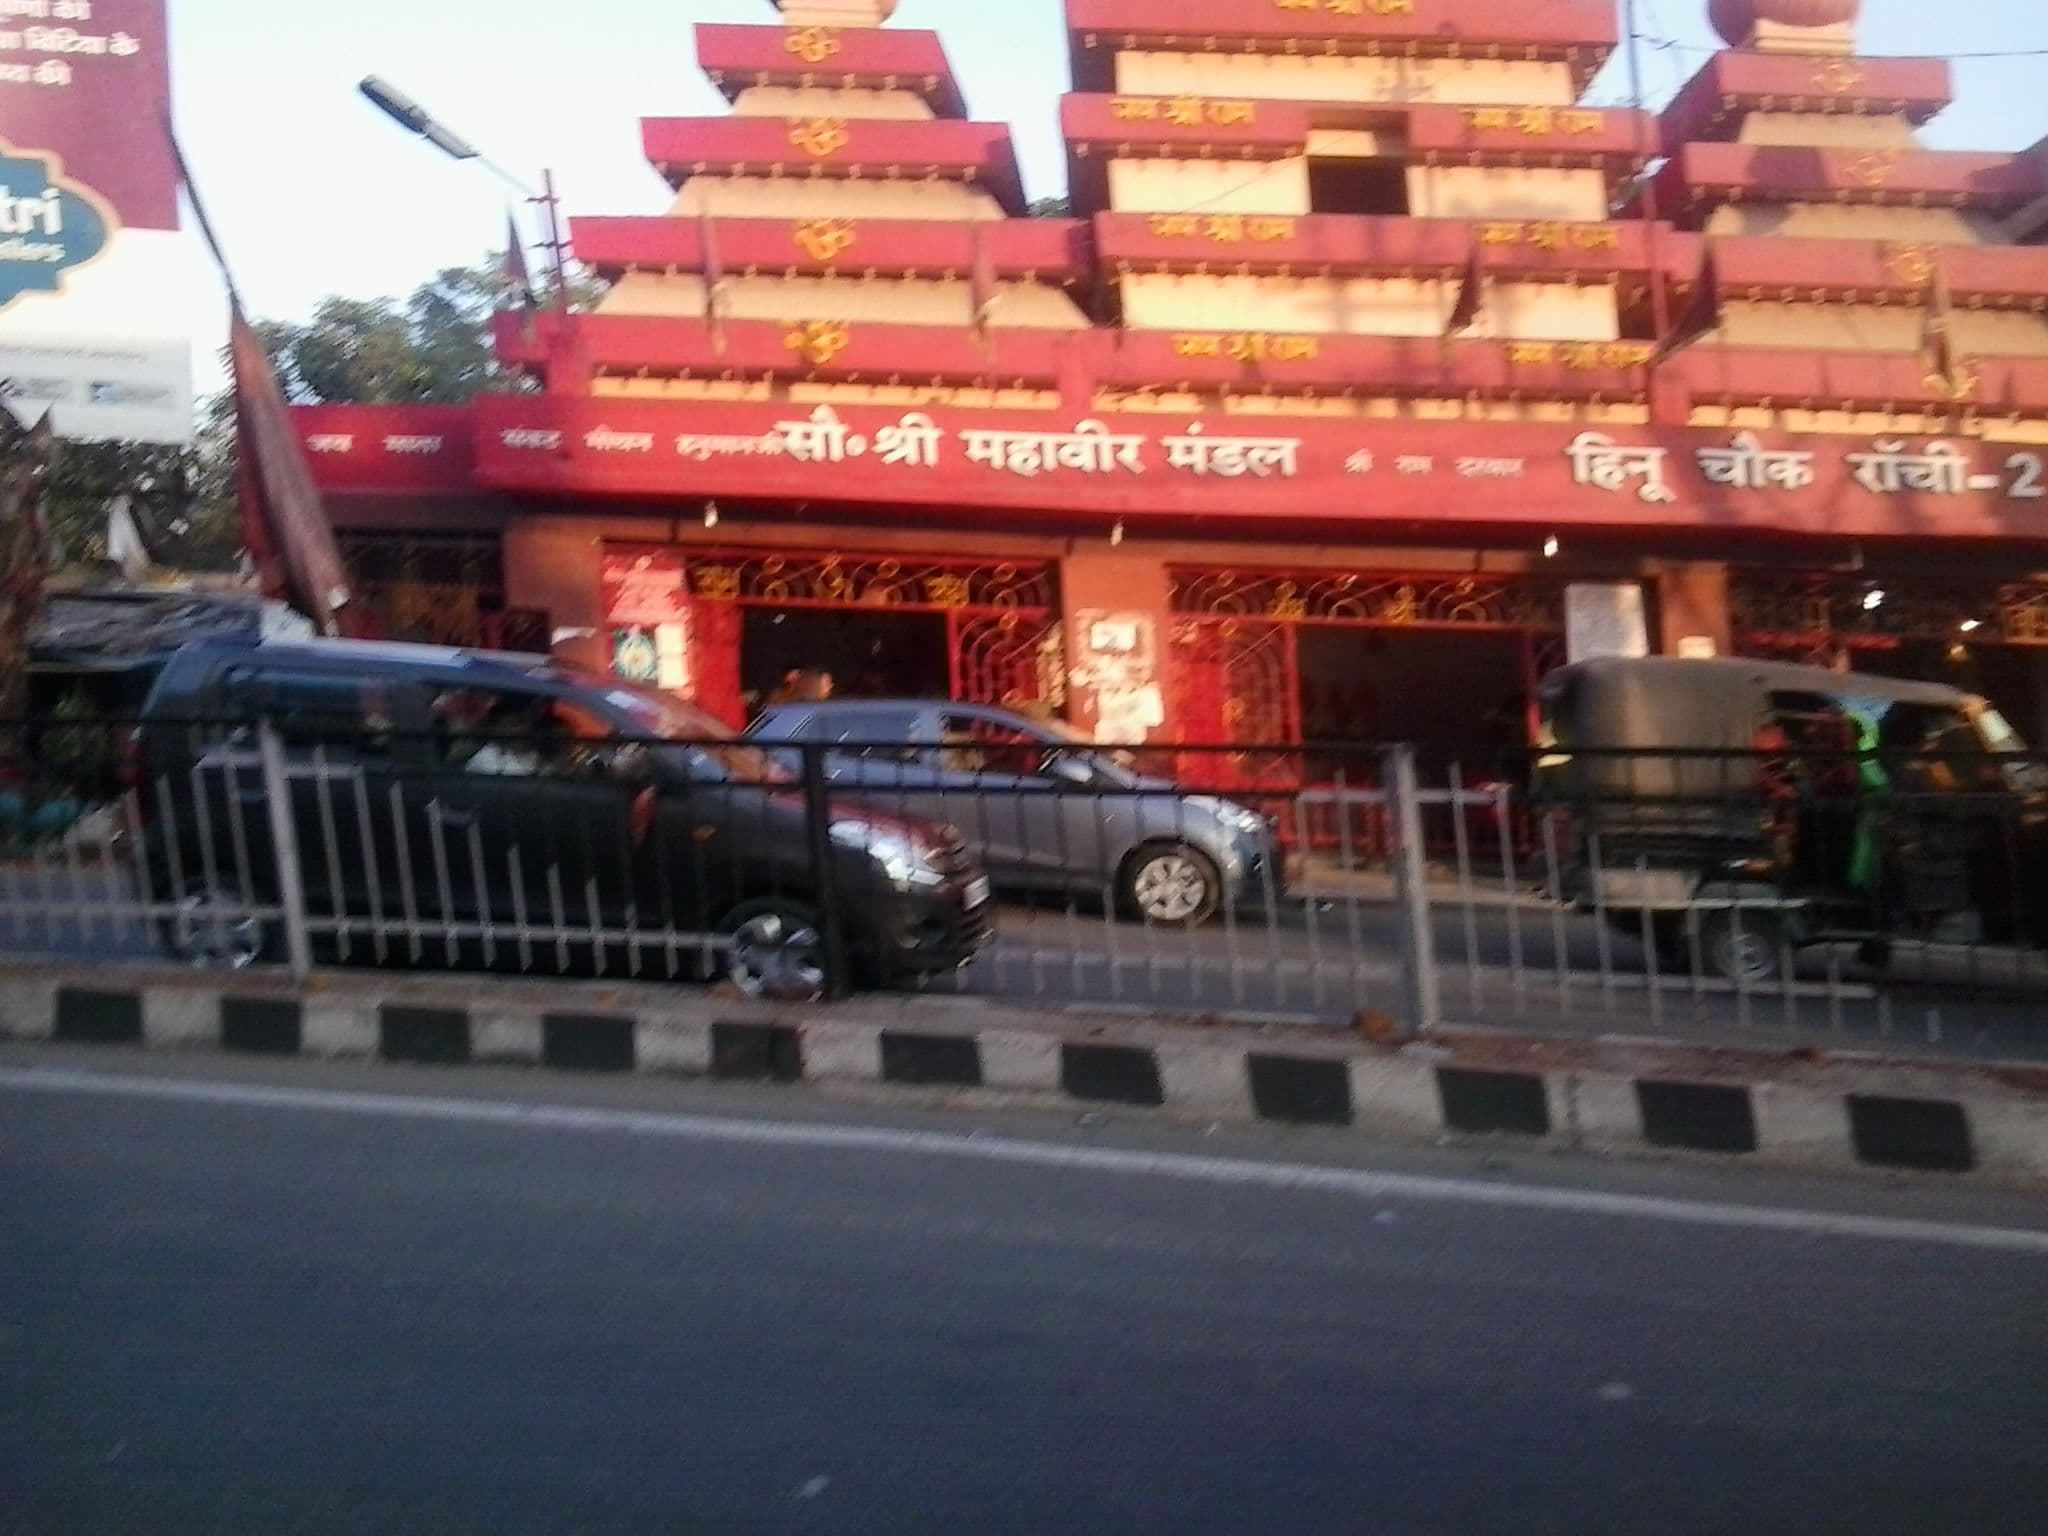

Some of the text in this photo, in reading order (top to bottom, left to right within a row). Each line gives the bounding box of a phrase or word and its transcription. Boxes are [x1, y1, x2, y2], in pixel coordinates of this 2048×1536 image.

[871, 412, 944, 467] श्री
[957, 418, 1147, 476] महावीर
[1160, 421, 1303, 477] मंडल
[1565, 431, 1678, 503] हिनू
[1697, 430, 1816, 491] चौक
